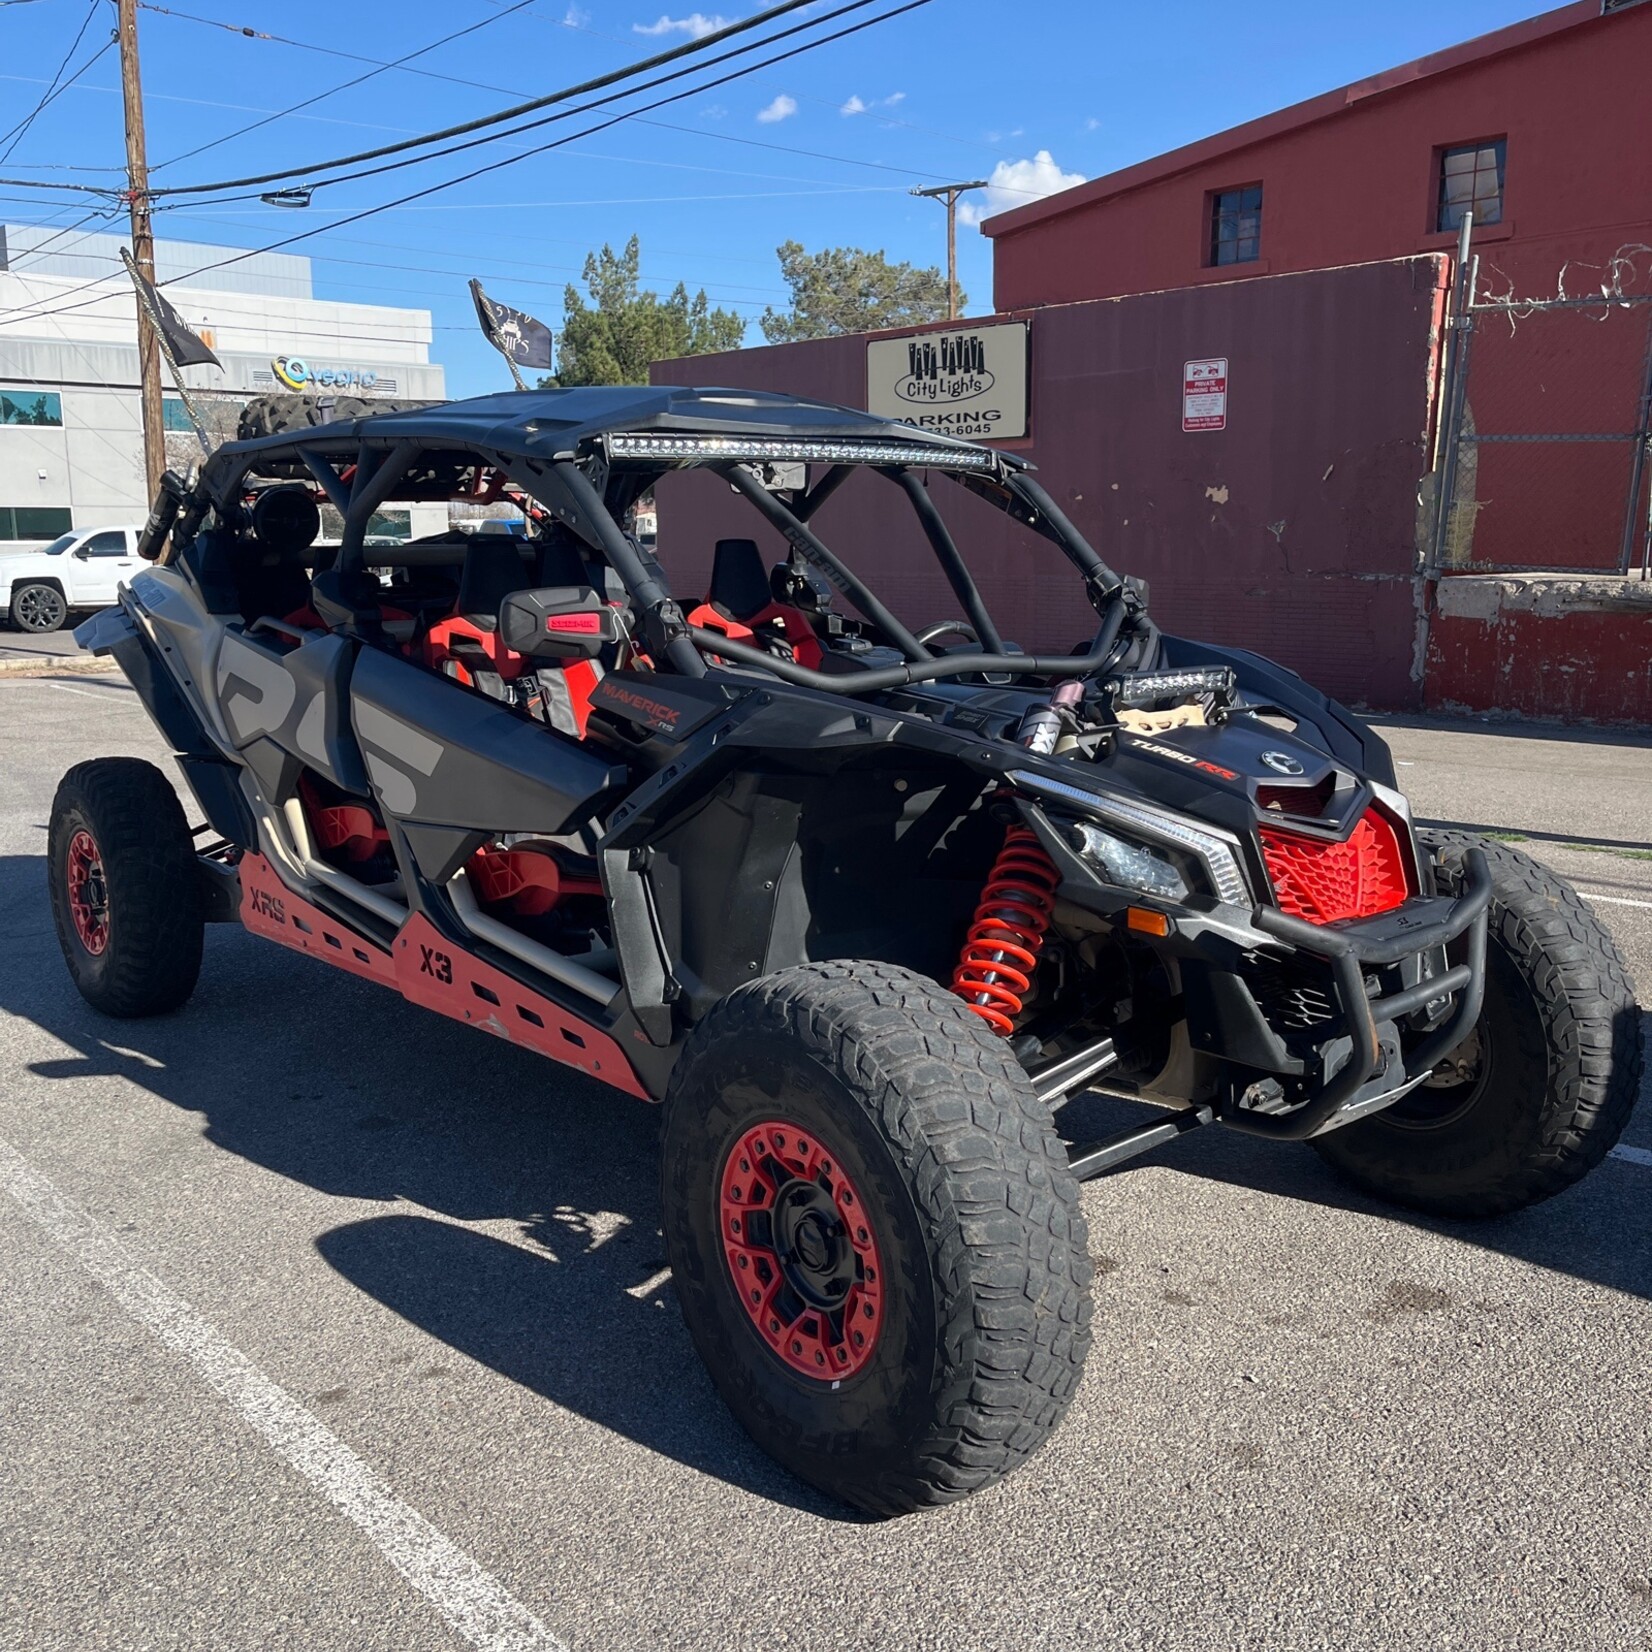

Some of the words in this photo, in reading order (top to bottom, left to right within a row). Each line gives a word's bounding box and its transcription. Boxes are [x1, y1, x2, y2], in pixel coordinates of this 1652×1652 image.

[907, 382, 937, 399] City
[940, 374, 982, 398] Lights
[892, 410, 1001, 427] ARKING
[928, 423, 991, 435] 33-6045
[603, 682, 681, 724] MAVERICK
[1131, 739, 1198, 764] TURBO
[1195, 760, 1237, 781] RR
[250, 886, 286, 925] XRS
[420, 944, 453, 985] X3
